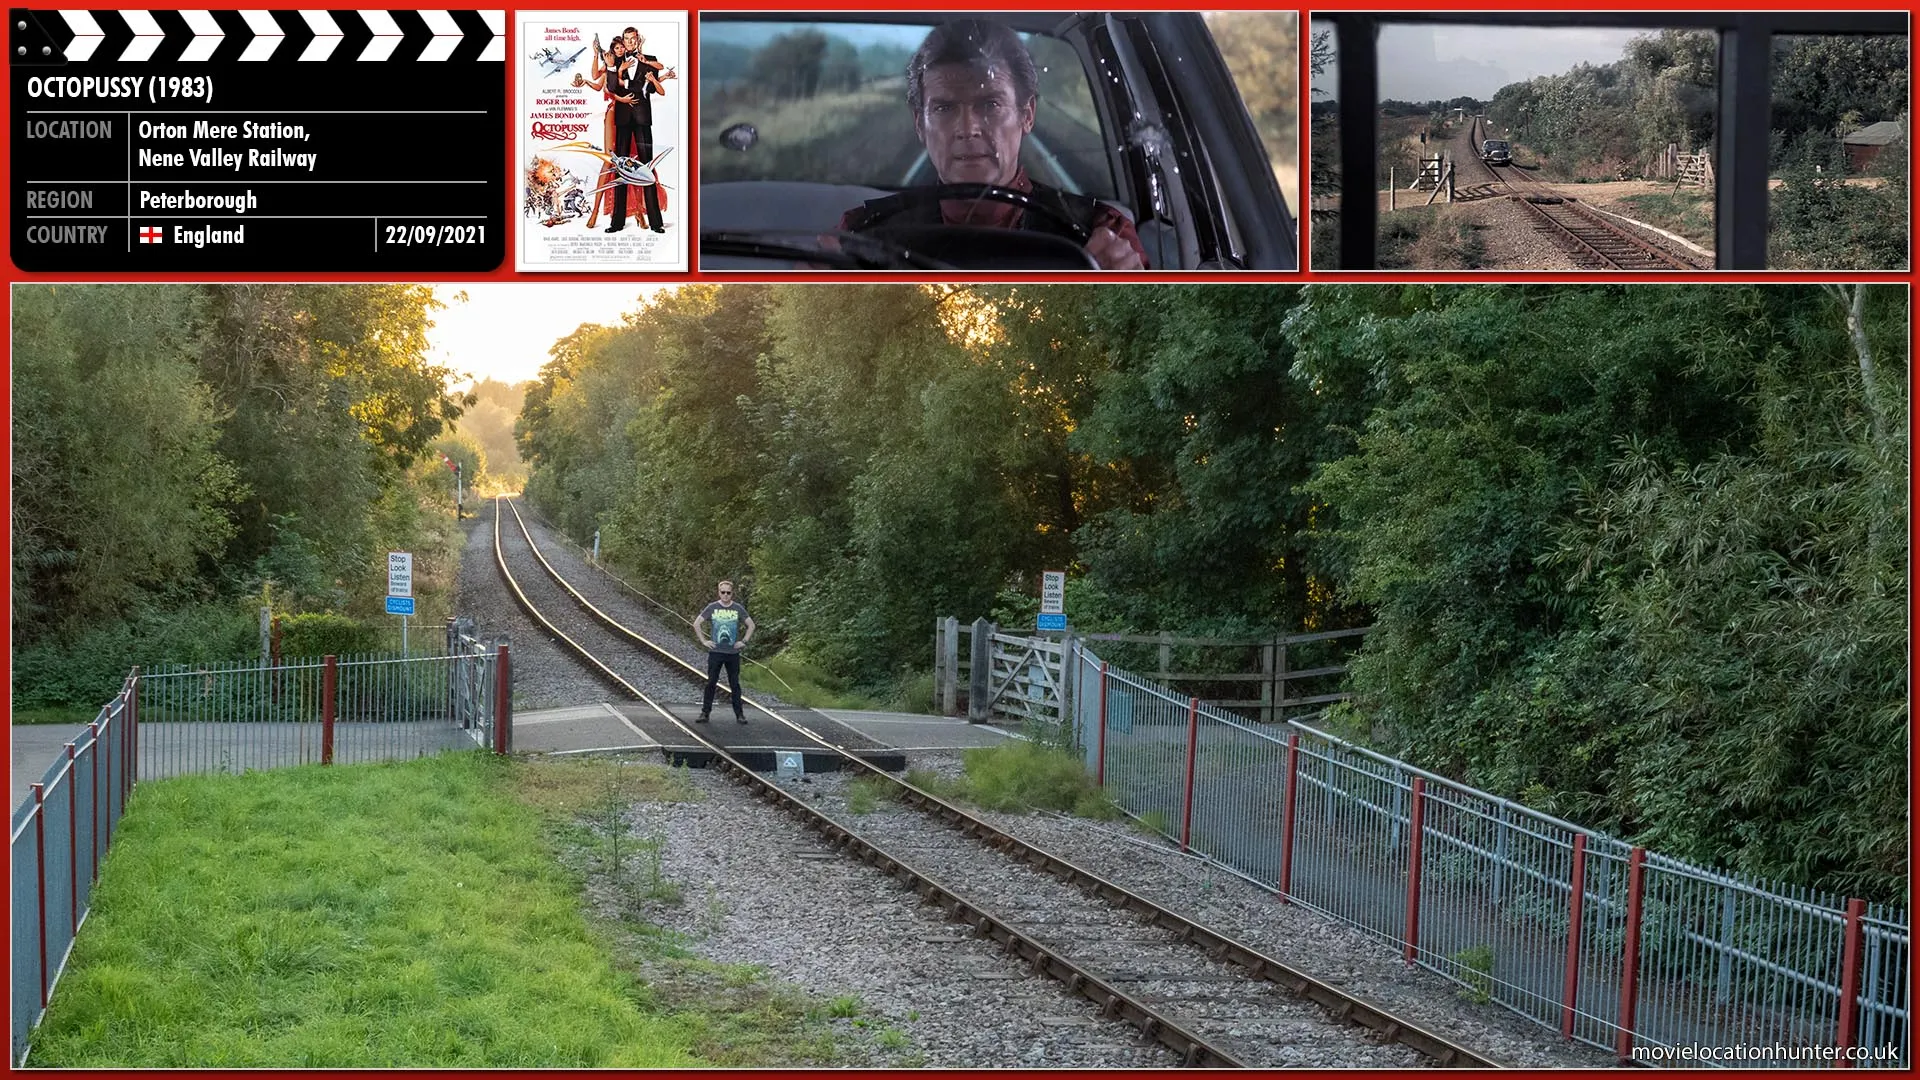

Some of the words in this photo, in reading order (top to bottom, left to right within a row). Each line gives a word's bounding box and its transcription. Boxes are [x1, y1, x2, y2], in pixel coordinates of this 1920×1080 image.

[390, 555, 406, 563] Stop
[390, 573, 410, 581] Listen
[1045, 574, 1060, 582] Stop
[711, 609, 739, 620] JAWS
